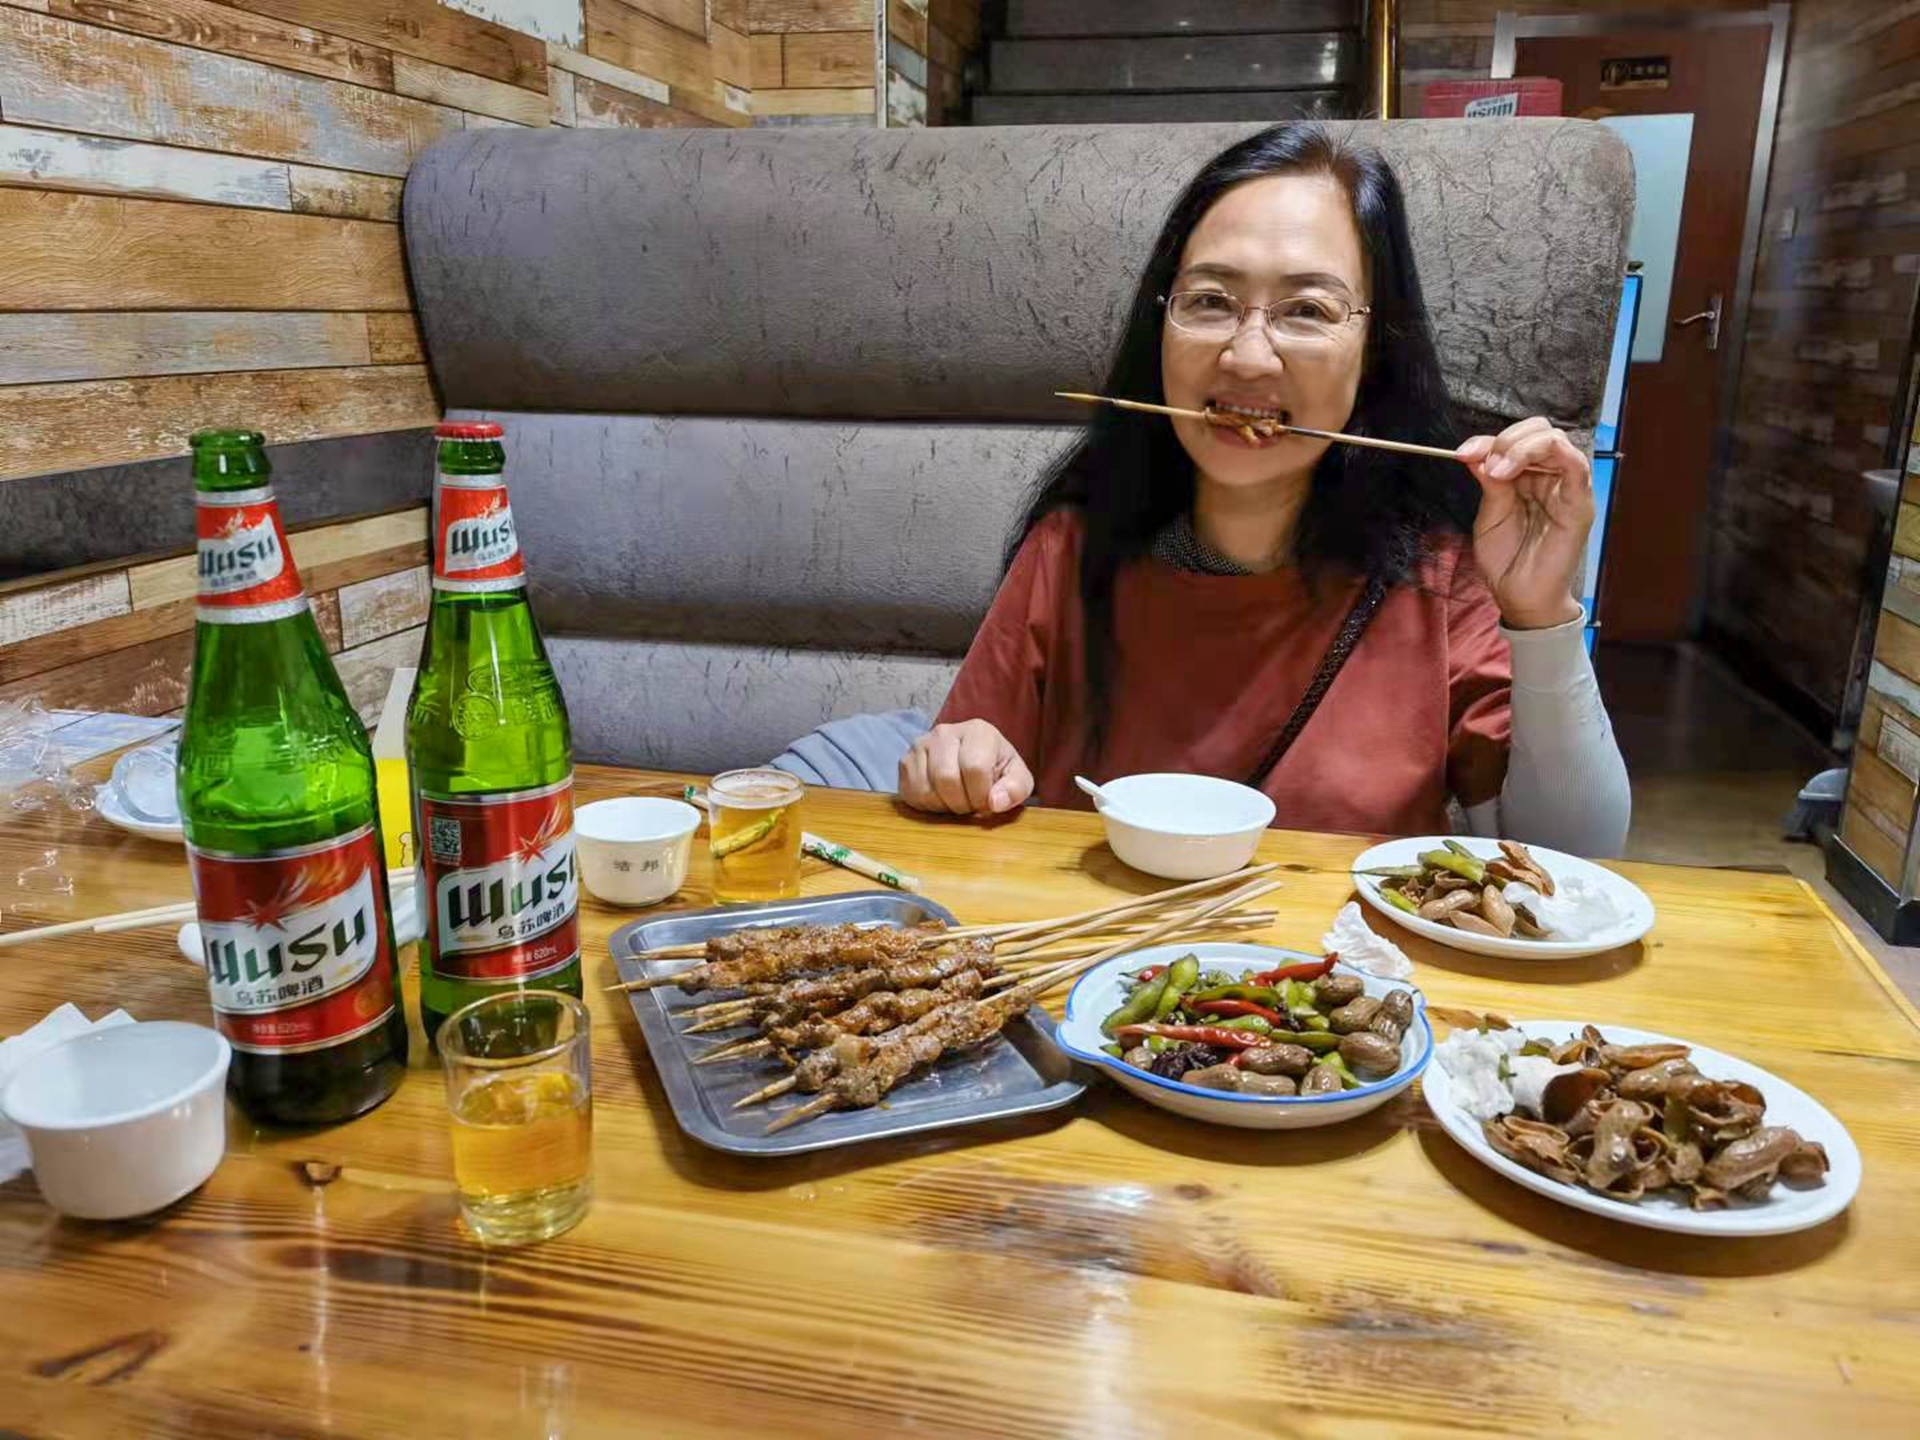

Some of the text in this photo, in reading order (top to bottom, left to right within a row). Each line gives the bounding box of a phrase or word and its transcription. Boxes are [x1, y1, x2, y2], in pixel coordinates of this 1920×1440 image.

[498, 901, 566, 939] 乌苏啤酒
[236, 974, 324, 1005] 乌苏啤酒
